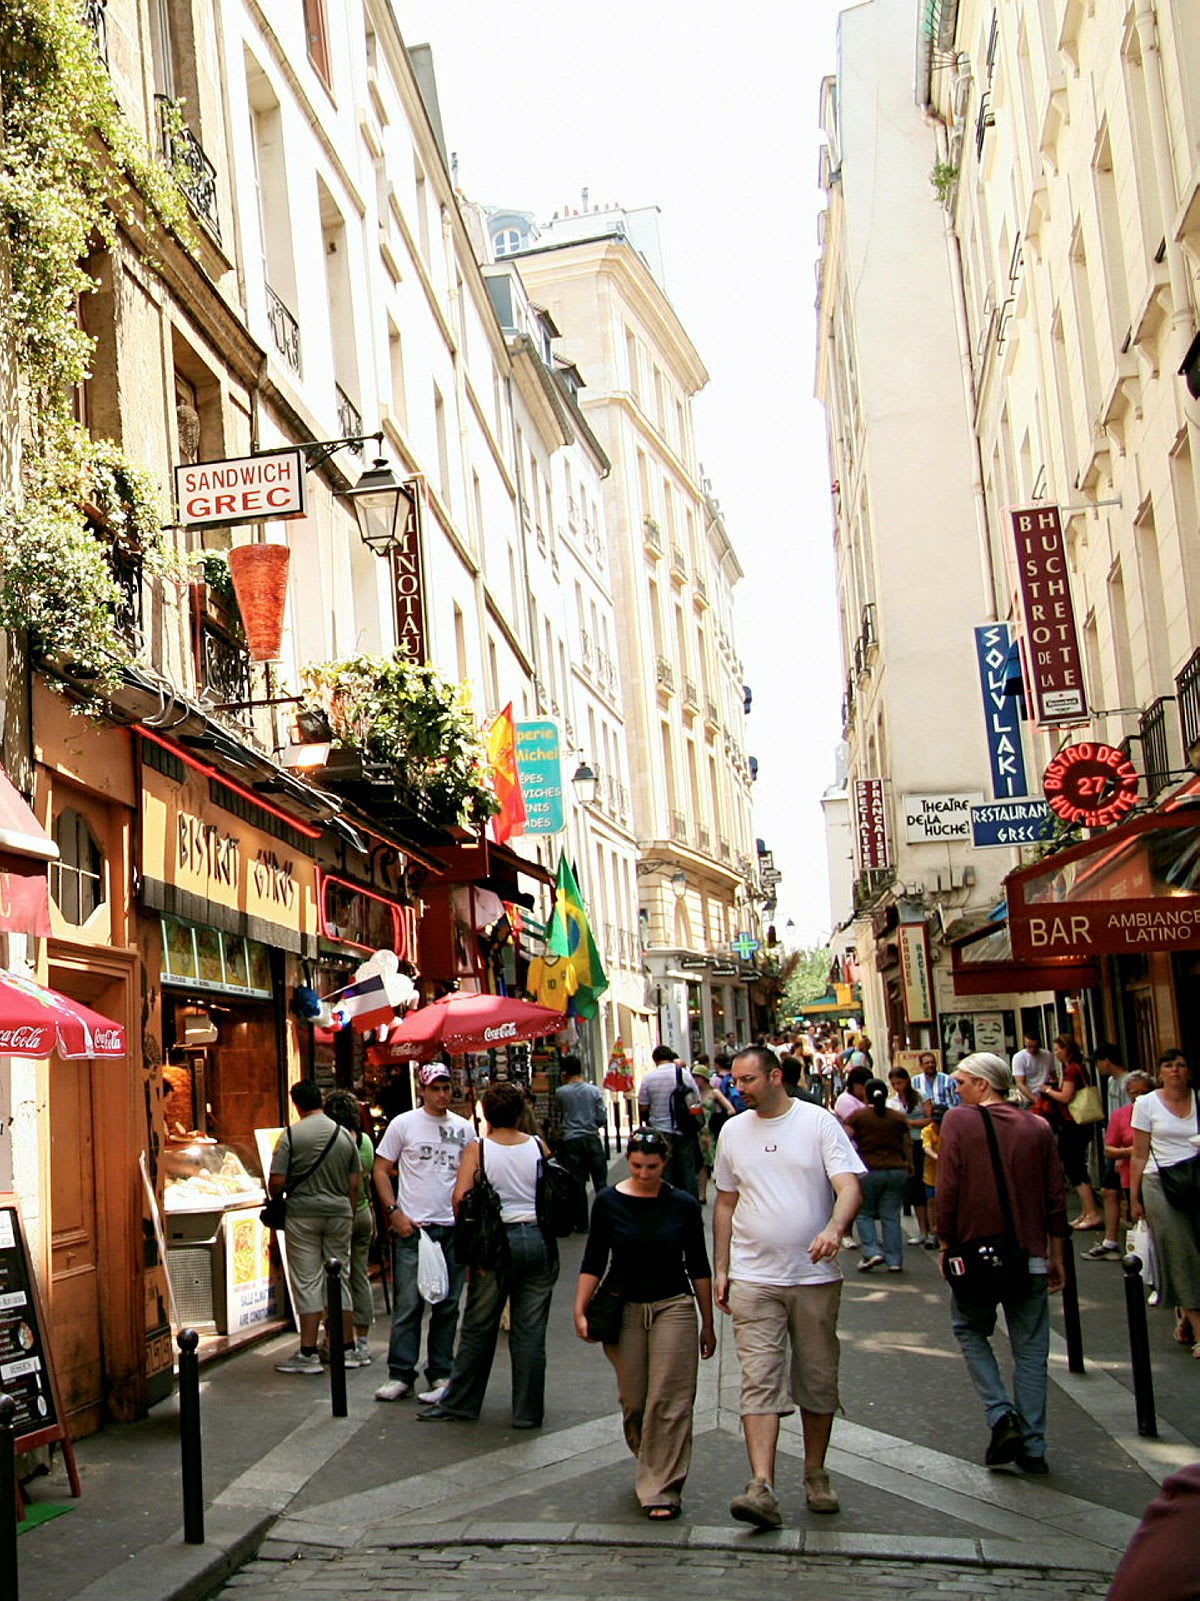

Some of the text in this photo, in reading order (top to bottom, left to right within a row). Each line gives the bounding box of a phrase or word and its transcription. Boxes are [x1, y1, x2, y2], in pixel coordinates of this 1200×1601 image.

[186, 461, 292, 493] SANDWICH
[186, 487, 292, 518] GREC
[396, 513, 422, 666] INOTAU
[1019, 515, 1051, 644] BISTRO
[1038, 512, 1076, 687] HUCHETTE
[1038, 650, 1052, 665] DE
[1040, 674, 1055, 688] LA
[1044, 742, 1093, 790] BISTRO
[1096, 745, 1123, 768] DE
[1077, 775, 1106, 796] 27
[920, 797, 970, 813] THEATRE
[972, 802, 1048, 824] RESTAURAN
[1049, 789, 1140, 827] HUCHETTE
[857, 781, 872, 869] SPECIALITES
[906, 813, 941, 826] DE LA
[924, 818, 971, 836] HUCHE
[997, 825, 1035, 843] GREC
[1029, 909, 1200, 947] BAR AMBIANCE
[1125, 925, 1192, 944] LATINO
